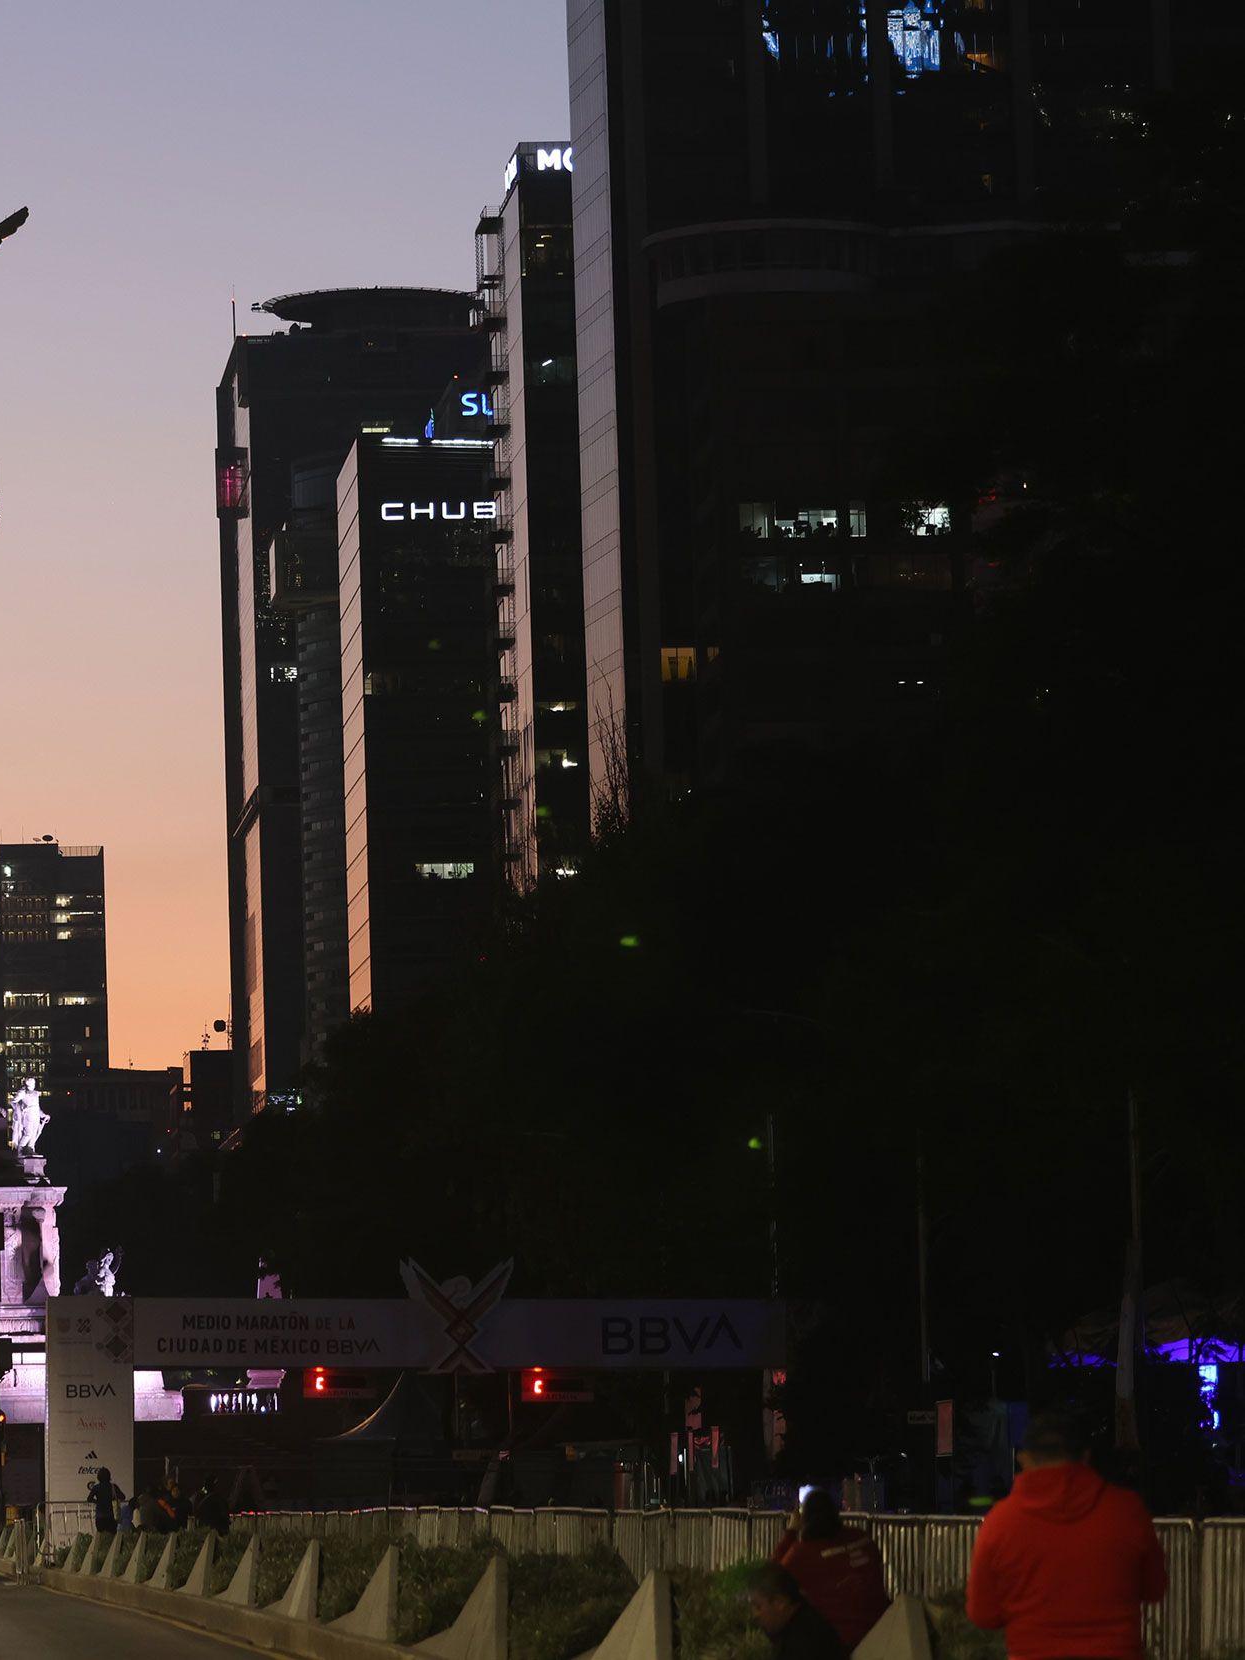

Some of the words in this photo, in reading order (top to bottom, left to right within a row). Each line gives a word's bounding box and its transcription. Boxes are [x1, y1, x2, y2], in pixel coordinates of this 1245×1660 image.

[381, 501, 496, 521] CHUB
[182, 1314, 231, 1330] MEDIO
[236, 1311, 309, 1330] MARATÓN
[315, 1316, 332, 1330] DE
[339, 1316, 356, 1330] LA
[601, 1311, 743, 1355] BBVA
[157, 1338, 223, 1354] CIUDAD
[227, 1338, 247, 1354] DE
[254, 1335, 320, 1354] MÉXICO
[326, 1339, 381, 1355] BBVA
[66, 1382, 116, 1399] BBVA
